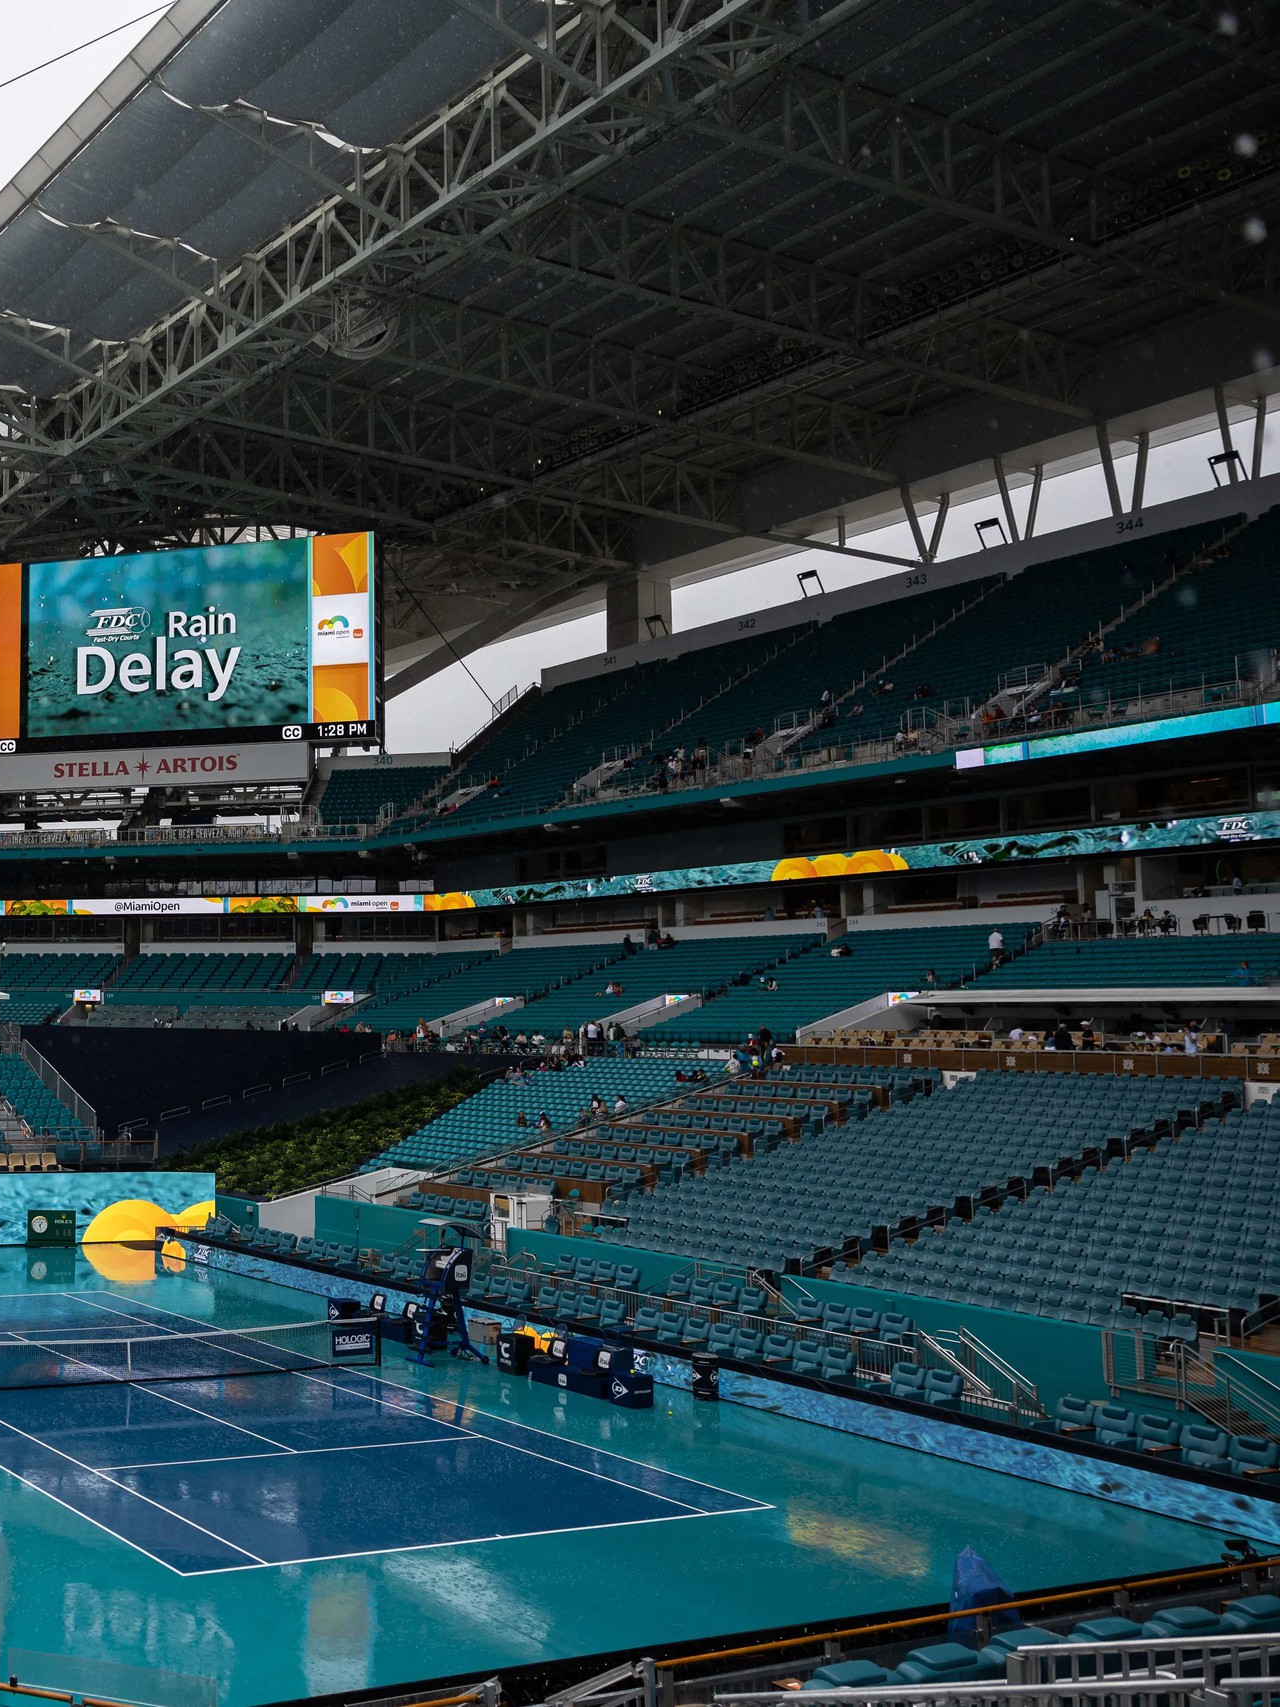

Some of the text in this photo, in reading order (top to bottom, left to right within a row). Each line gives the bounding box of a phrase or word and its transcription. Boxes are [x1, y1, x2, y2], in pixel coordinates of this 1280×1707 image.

[1116, 517, 1144, 534] 344
[906, 573, 927, 588] 343
[96, 613, 141, 629] FDC
[168, 606, 236, 638] Rain
[738, 618, 756, 631] 342
[603, 655, 617, 667] 341
[76, 636, 242, 702] Delay
[283, 727, 301, 738] CC
[317, 723, 367, 737] 1:28 PM
[0, 741, 15, 752] CC
[53, 754, 238, 779] STELLA ARTOIS
[373, 756, 392, 765] 340
[1222, 820, 1252, 830] FDC
[114, 901, 181, 913] @MiamiOpen
[335, 1333, 371, 1345] HOLOGIC
